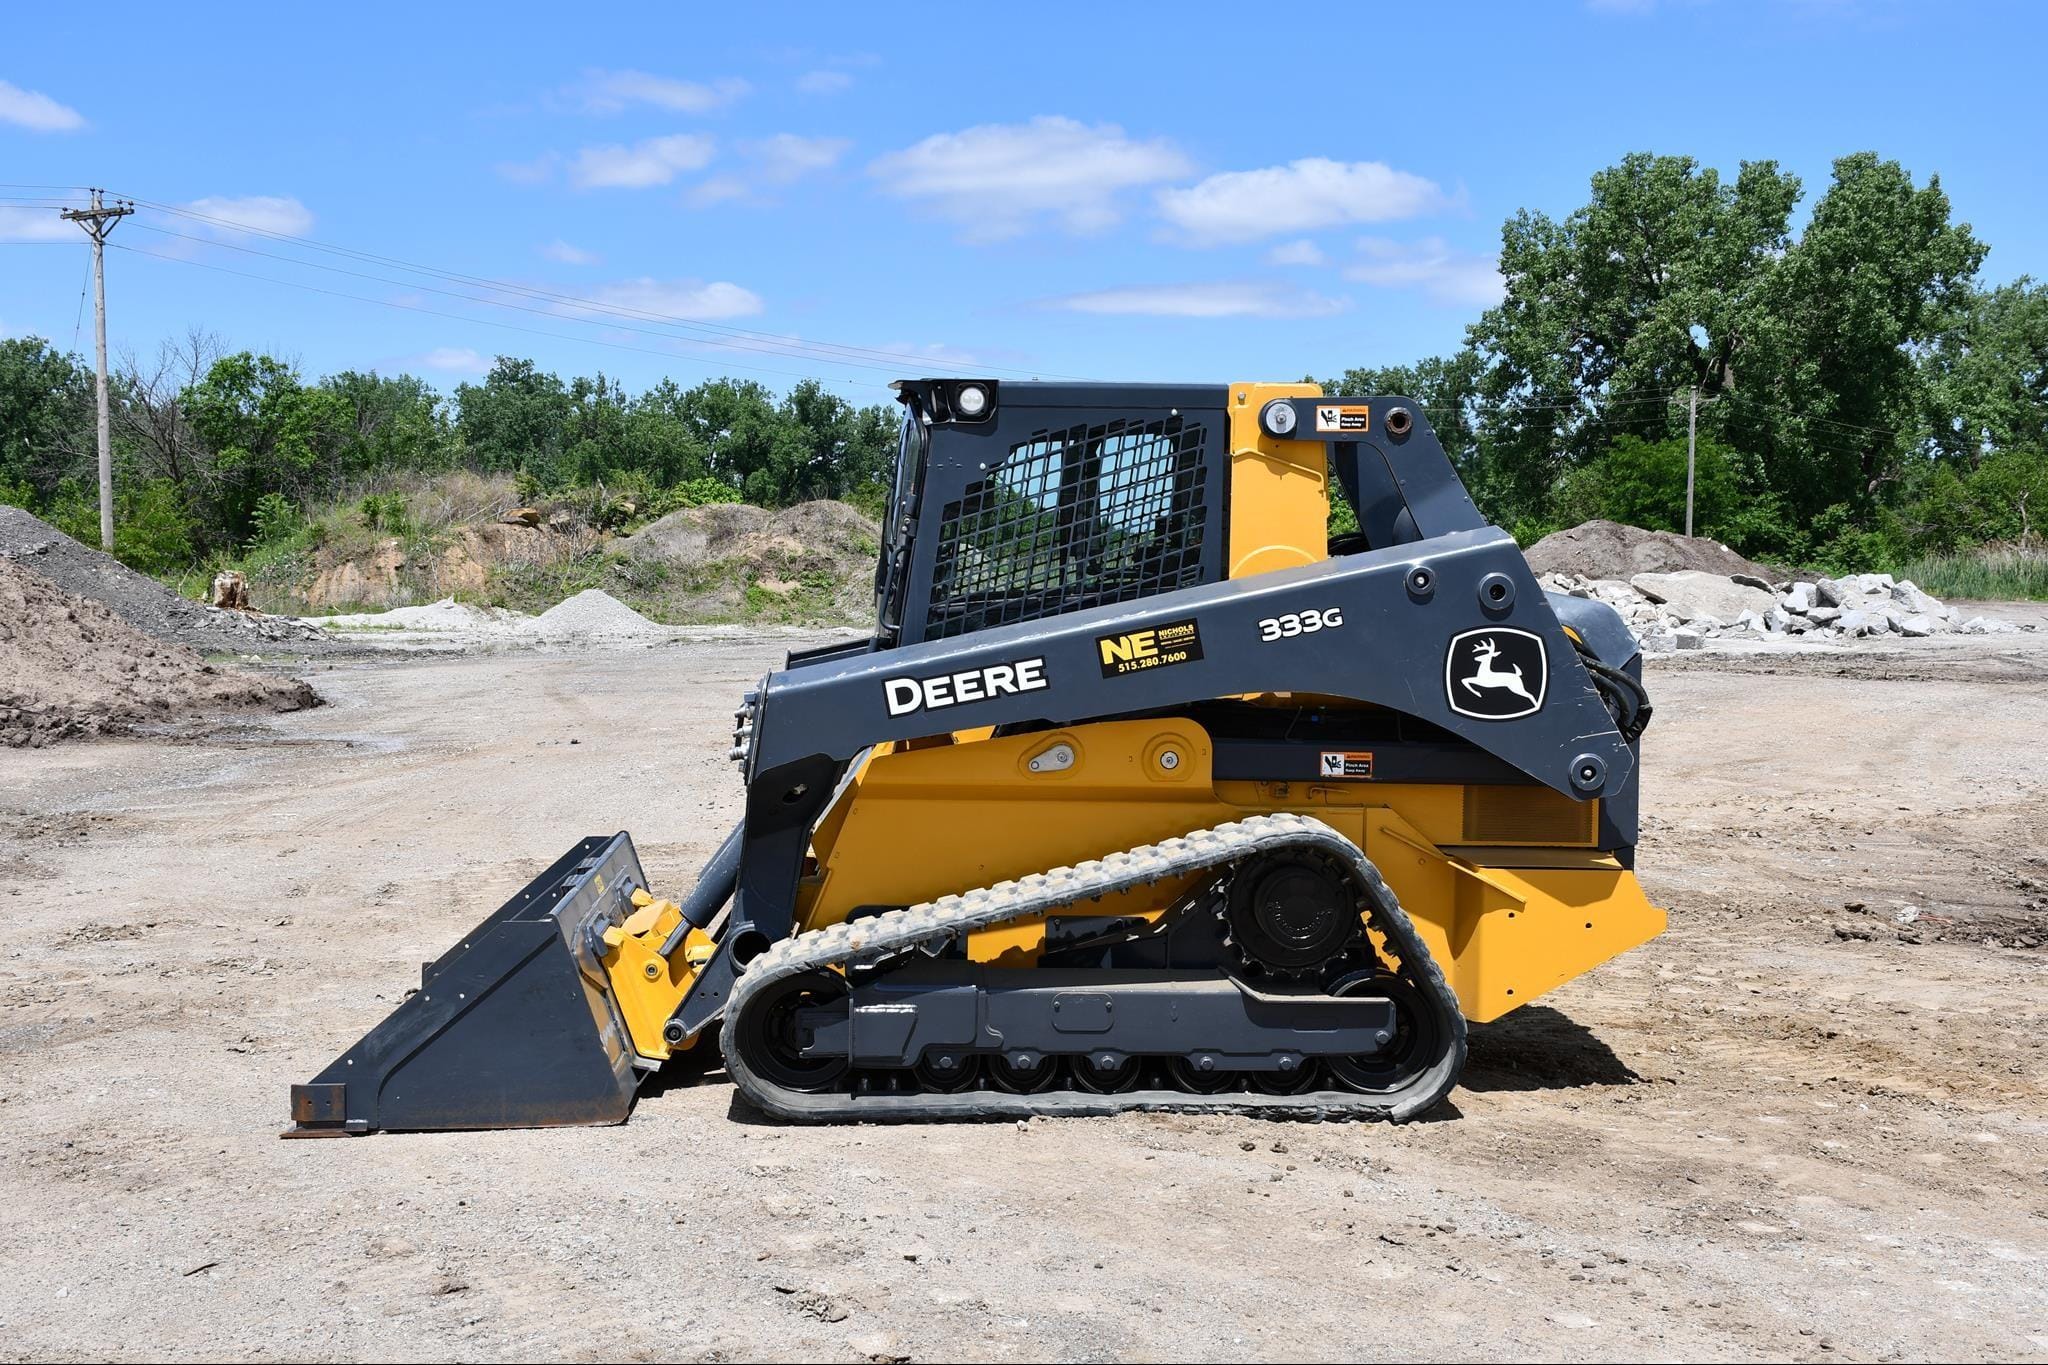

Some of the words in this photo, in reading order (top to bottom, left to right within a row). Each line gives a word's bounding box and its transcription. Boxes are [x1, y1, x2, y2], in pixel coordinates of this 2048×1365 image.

[1158, 624, 1194, 636] NICHOLS
[1259, 607, 1343, 641] 333G
[1100, 630, 1158, 664] NE
[1118, 651, 1187, 672] 515.280.7600
[885, 658, 1047, 715] DEERE
